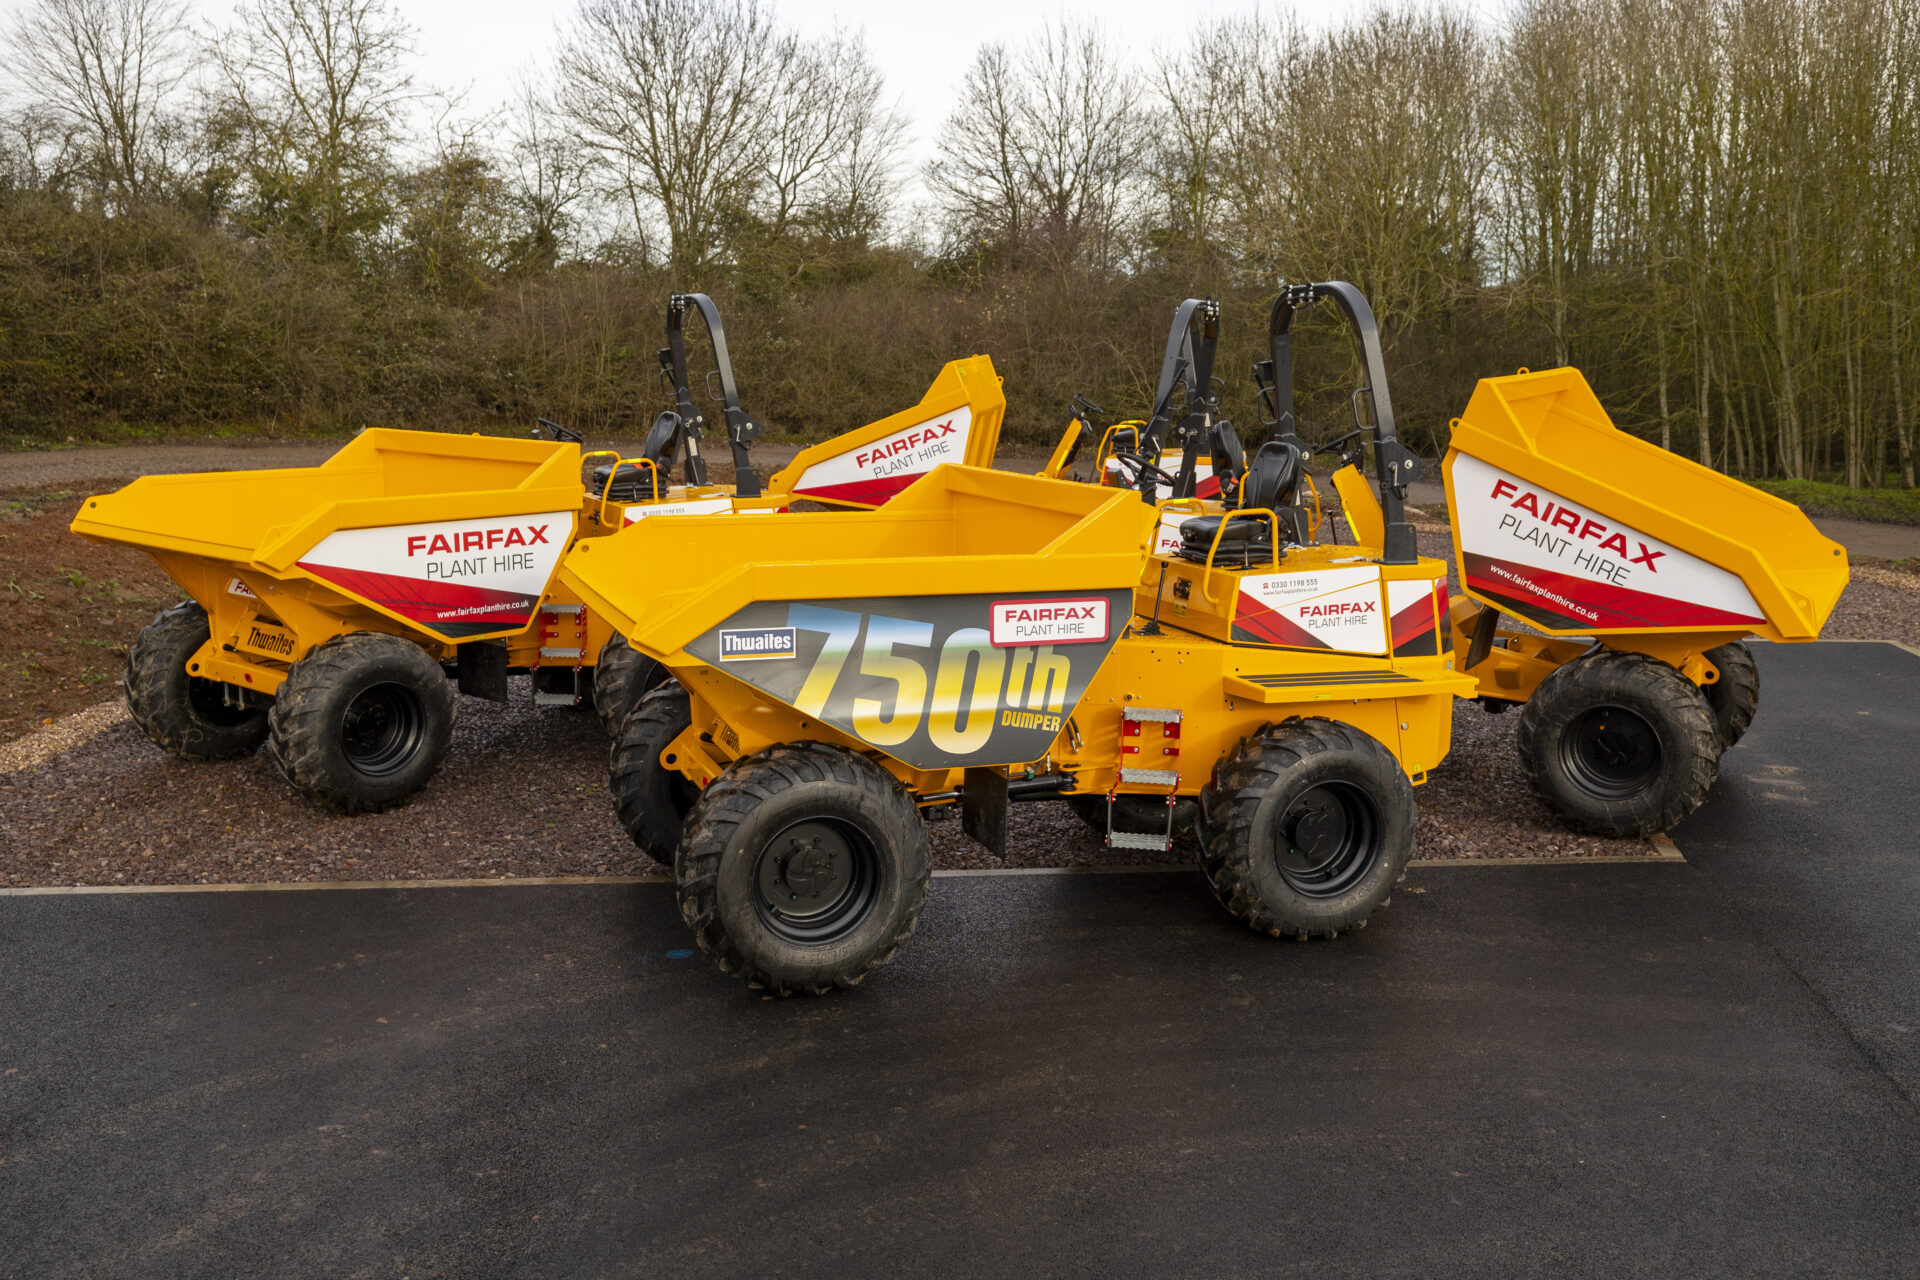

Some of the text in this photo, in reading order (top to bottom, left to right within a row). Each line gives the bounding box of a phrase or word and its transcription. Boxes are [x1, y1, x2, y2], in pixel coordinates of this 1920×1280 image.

[856, 419, 957, 468] FAIRFAX
[873, 440, 951, 478] PLANT HIRE
[1491, 479, 1667, 574] FAIRFAX
[407, 524, 550, 557] FAIRFAX
[1499, 513, 1631, 587] PLANT HIRE
[427, 552, 534, 579] PLANT HIRE
[1271, 581, 1288, 589] 0330
[1306, 578, 1318, 586] 555
[1490, 564, 1599, 622] www.fairfaxplanthire.co.uk
[437, 599, 530, 619] www.fairfaxplanthire.co.uk
[1005, 606, 1096, 622] FAIRFAX
[1300, 601, 1376, 617] FAIRFAX
[1016, 623, 1085, 636] PLANT HIRE
[1308, 615, 1368, 629] PLANT HIRE
[247, 626, 296, 655] Thwaites
[724, 633, 791, 652] Thwaites
[1001, 710, 1061, 732] DUMPER
